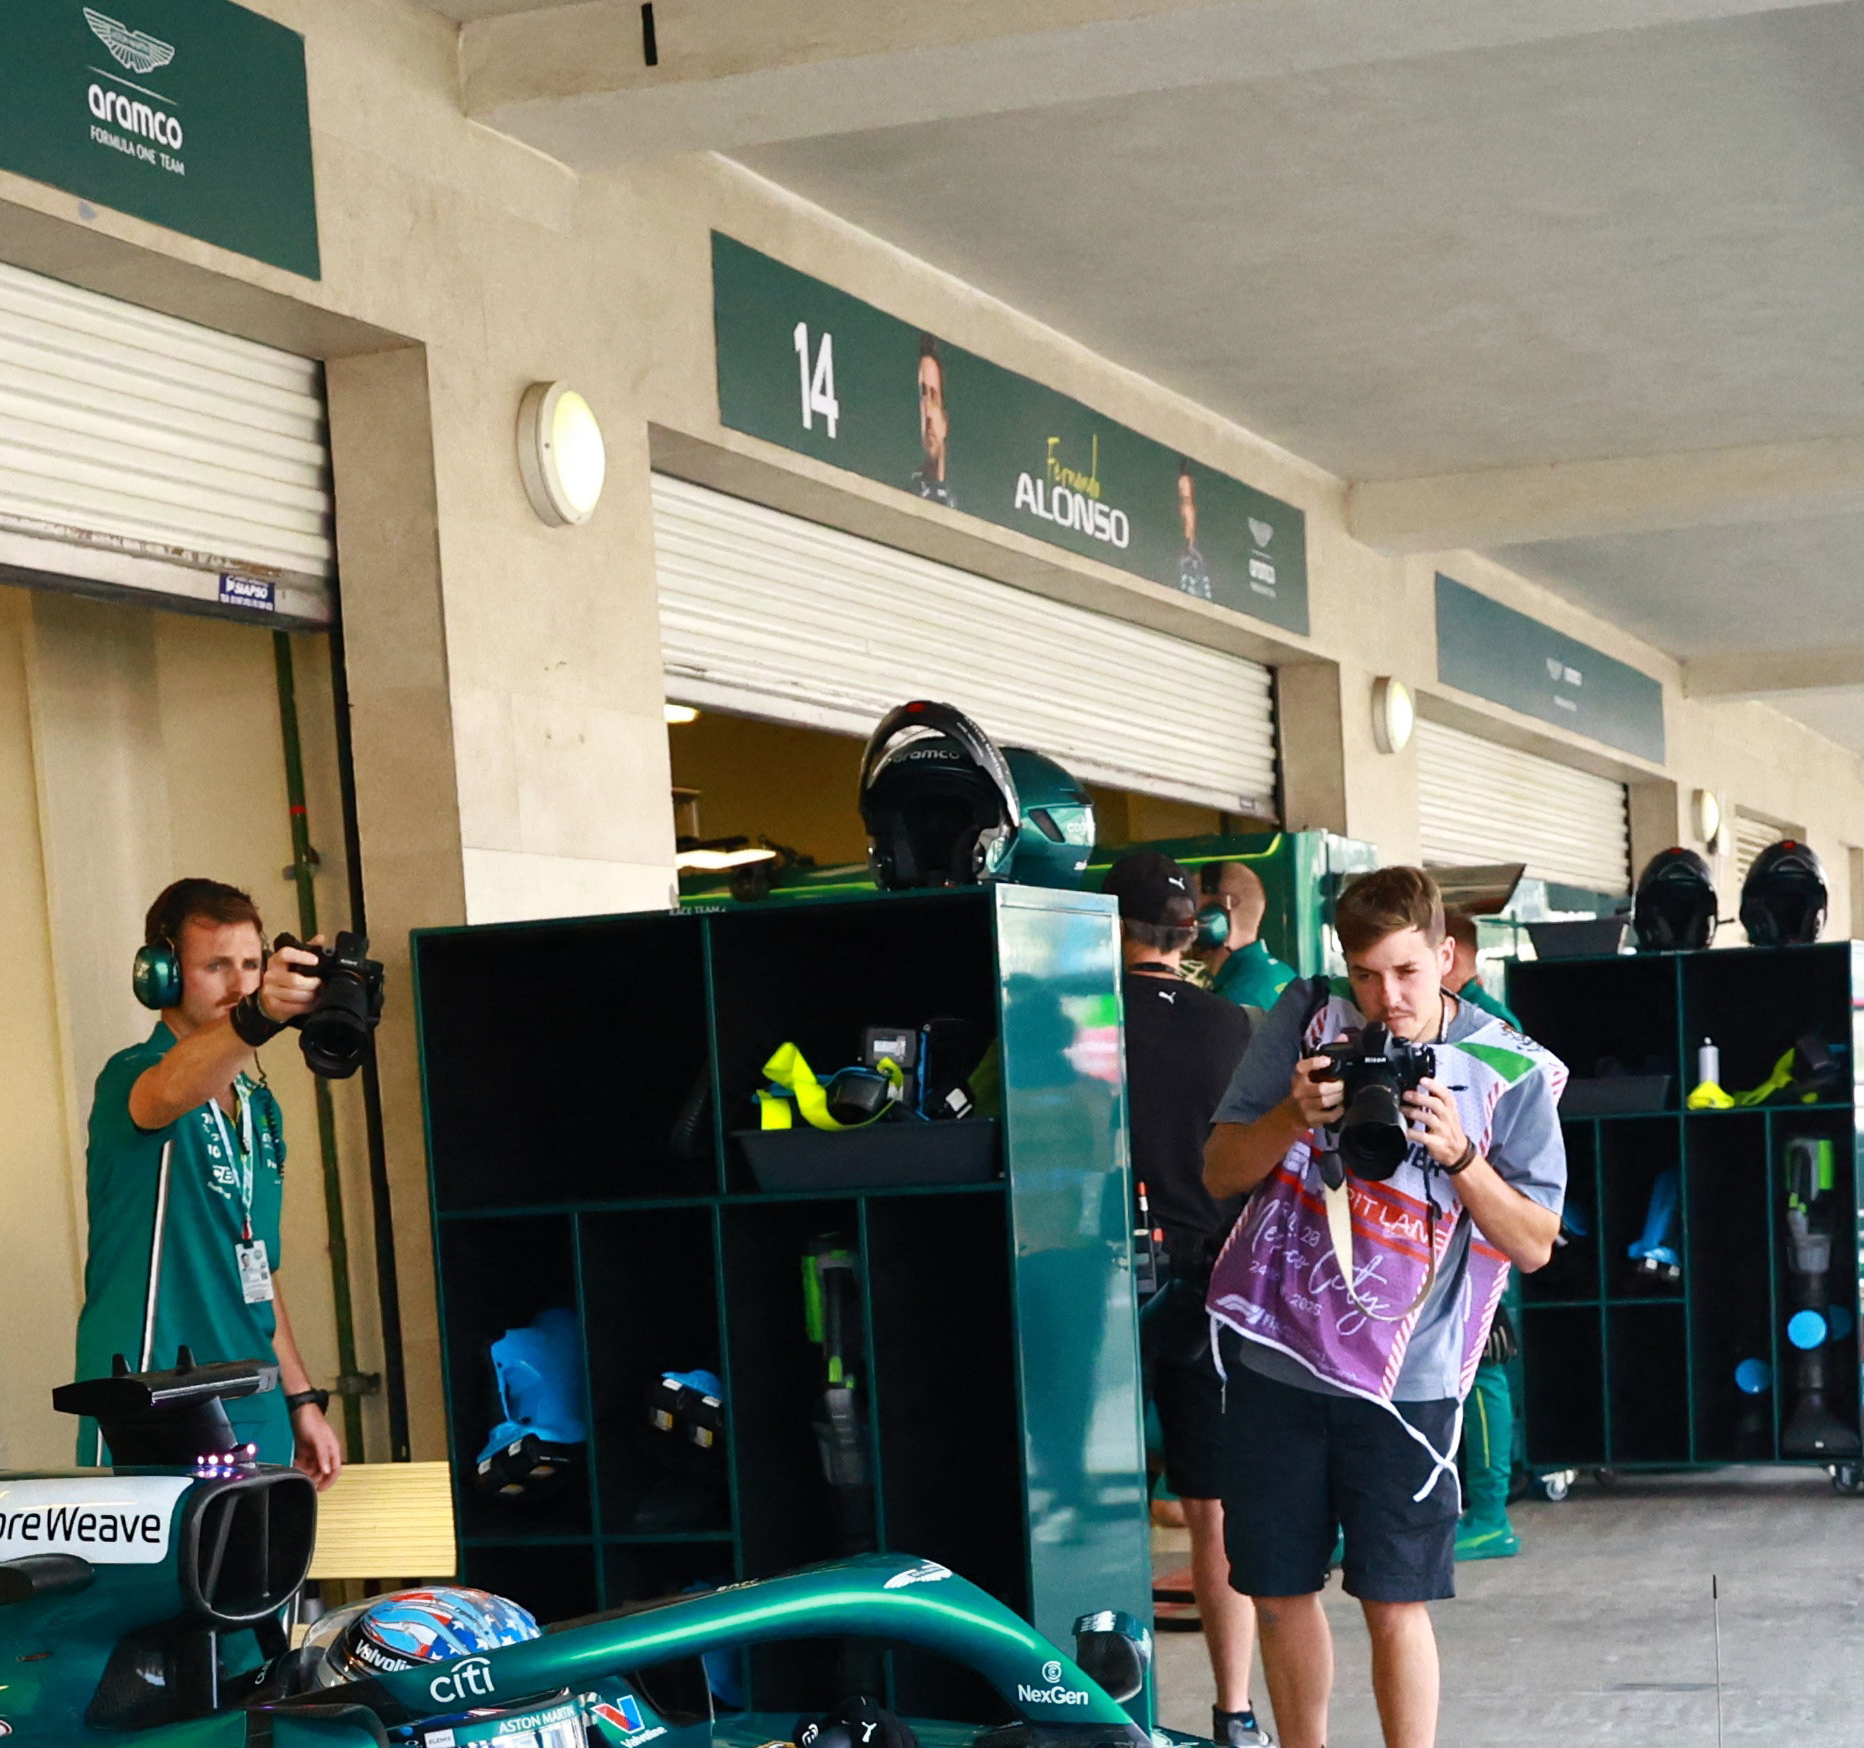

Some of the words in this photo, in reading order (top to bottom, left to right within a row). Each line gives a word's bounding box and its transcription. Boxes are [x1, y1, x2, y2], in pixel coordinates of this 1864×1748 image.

[88, 84, 183, 149] aramco
[90, 125, 136, 157] FORMULA
[137, 144, 157, 165] ONE
[159, 152, 186, 176] TEAM
[793, 322, 839, 439] 14
[1014, 472, 1129, 549] ALONSO
[429, 1656, 496, 1703] citi
[1017, 1684, 1089, 1705] NexGen
[499, 1714, 540, 1735] ASTON
[540, 1704, 576, 1727] MARTIN
